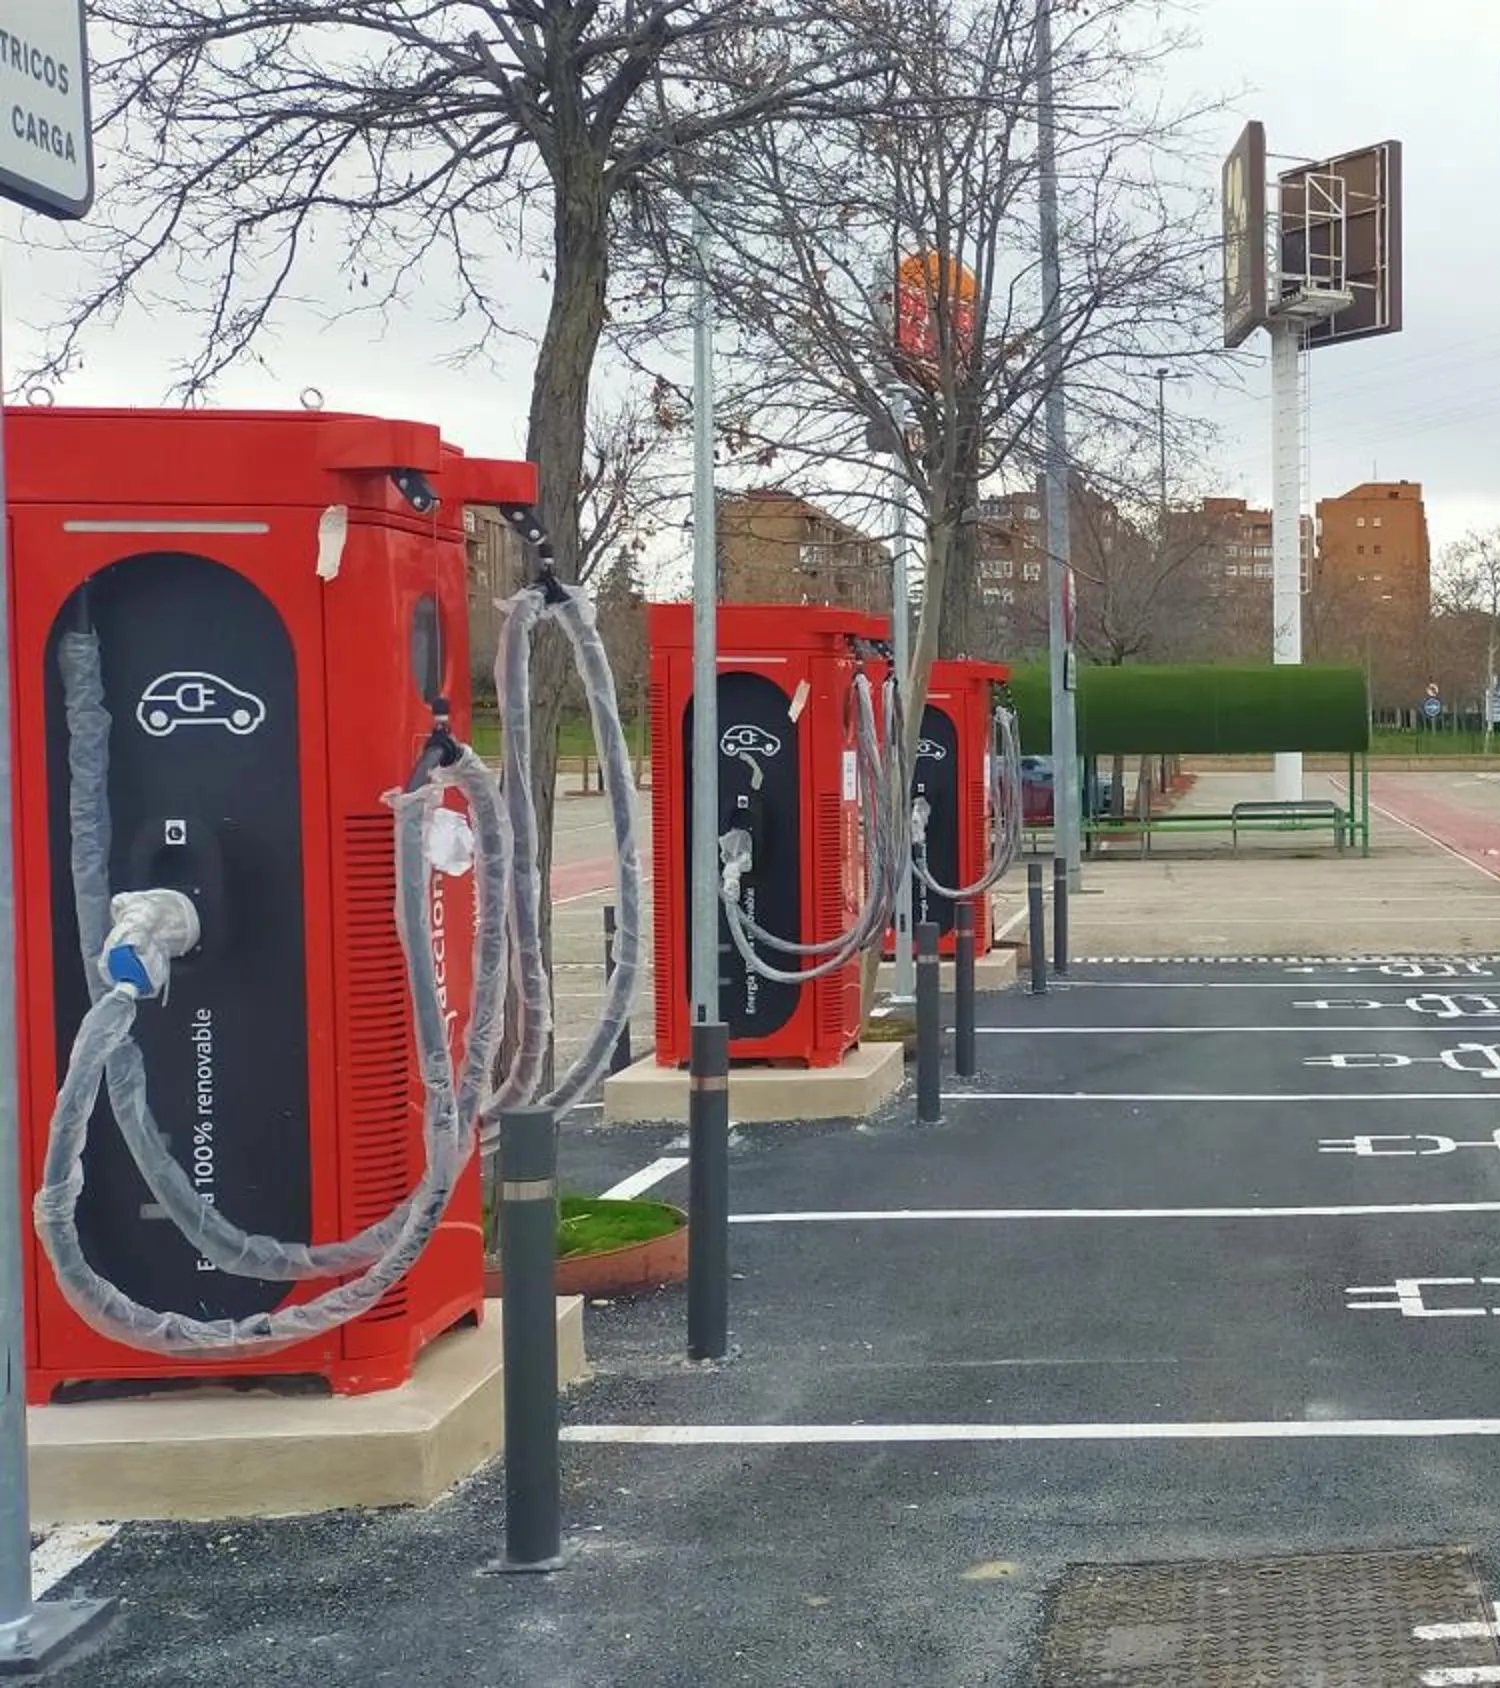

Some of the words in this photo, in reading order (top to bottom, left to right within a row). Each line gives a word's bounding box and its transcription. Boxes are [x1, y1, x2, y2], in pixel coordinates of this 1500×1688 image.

[12, 104, 76, 164] CARGA
[432, 874, 448, 1010] accion
[191, 1008, 213, 1115] renovable
[193, 1120, 215, 1187] 100%
